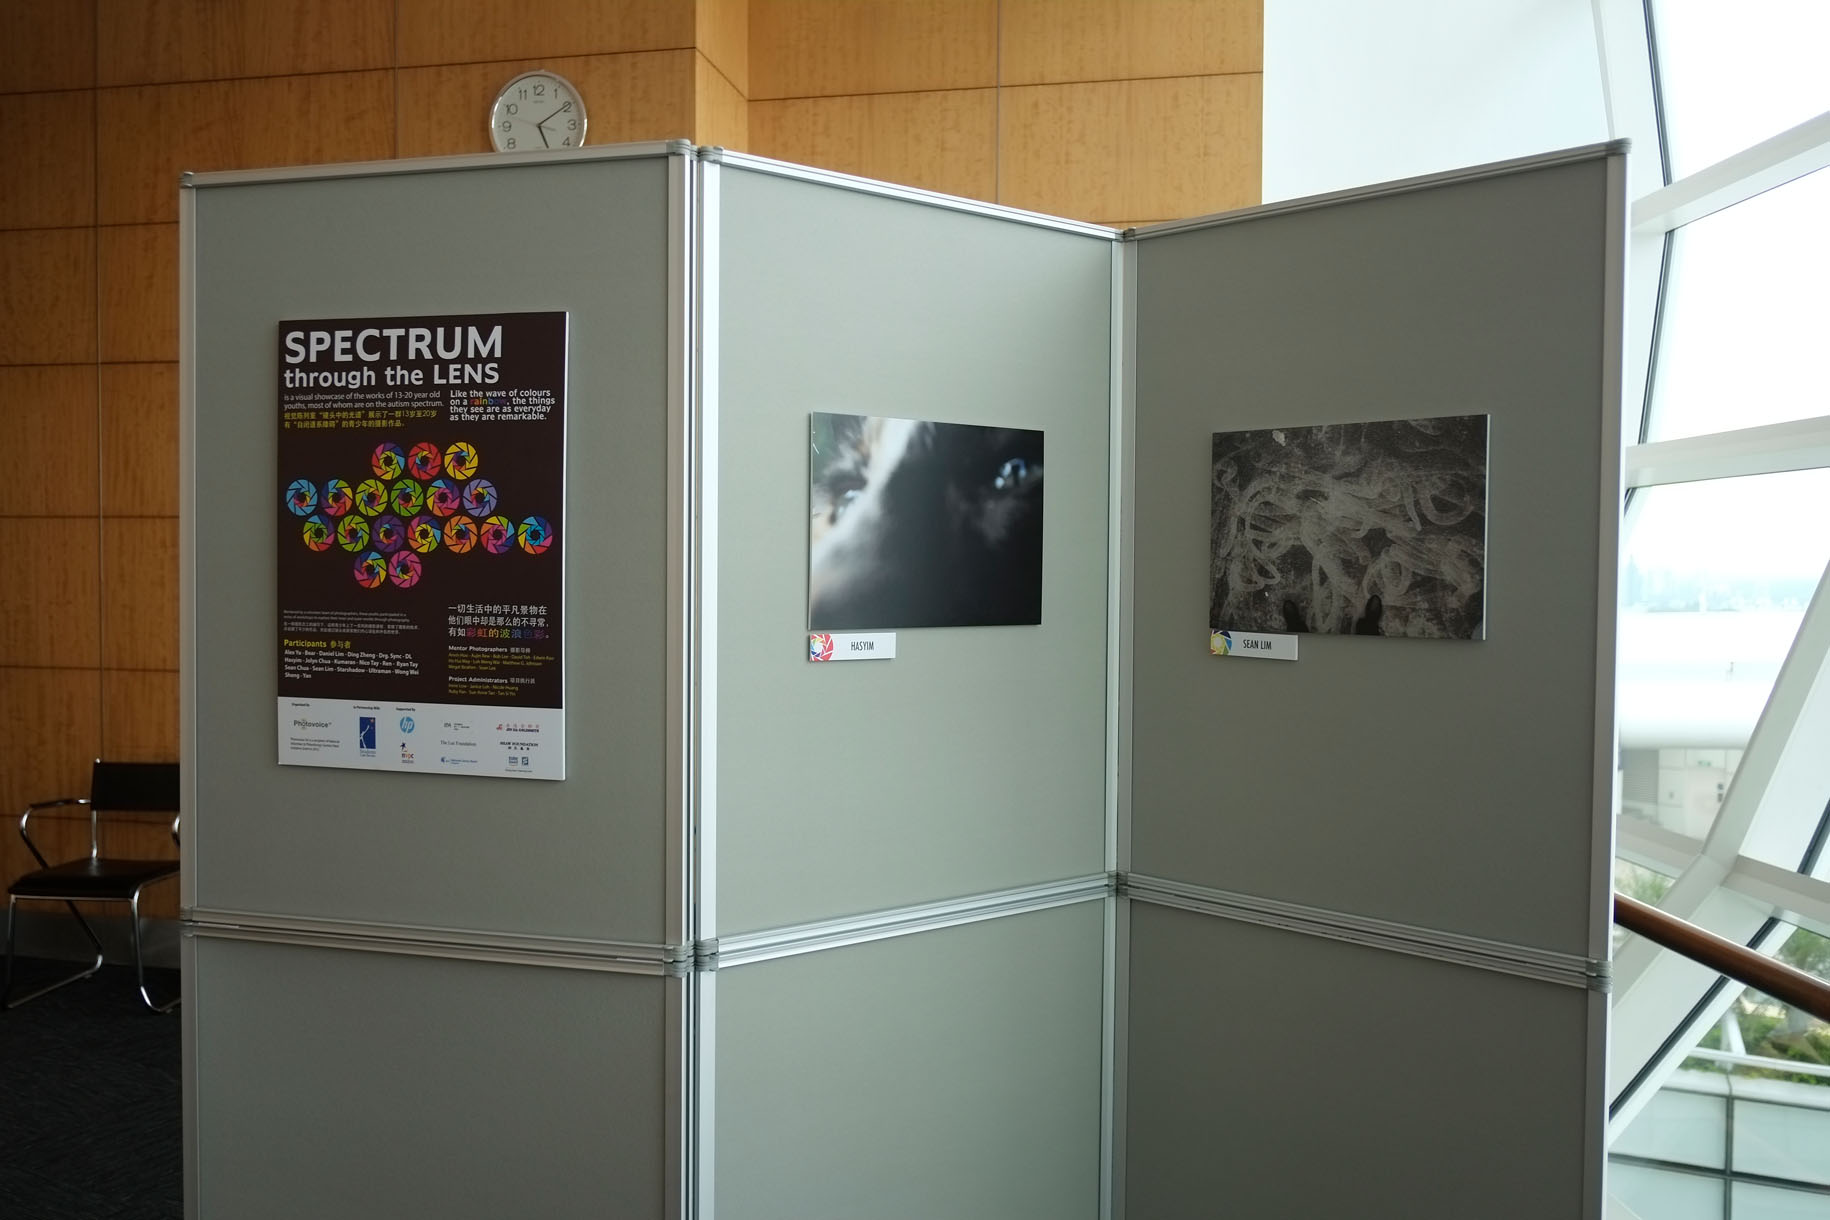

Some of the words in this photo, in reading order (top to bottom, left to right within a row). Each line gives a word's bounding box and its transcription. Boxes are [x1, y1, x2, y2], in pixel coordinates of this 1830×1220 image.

[519, 89, 527, 100] 11
[533, 84, 545, 96] 12
[554, 88, 558, 99] 1
[506, 104, 518, 115] 10
[563, 101, 572, 112] 2
[502, 121, 512, 132] 9
[568, 120, 576, 130] 3
[507, 138, 516, 149] 8
[562, 137, 570, 146] 4
[285, 326, 502, 364] SPECTRUM
[284, 366, 376, 388] through
[384, 366, 424, 386] the
[434, 363, 500, 384] LENS
[529, 397, 555, 405] things
[514, 405, 551, 414] everyday
[462, 413, 479, 421] they
[448, 604, 548, 615] 一切生活中的平凡景物在
[284, 640, 327, 648] Participants
[851, 641, 874, 651] HASYIM
[1243, 639, 1258, 649] SEAN
[1261, 641, 1272, 650] LIM
